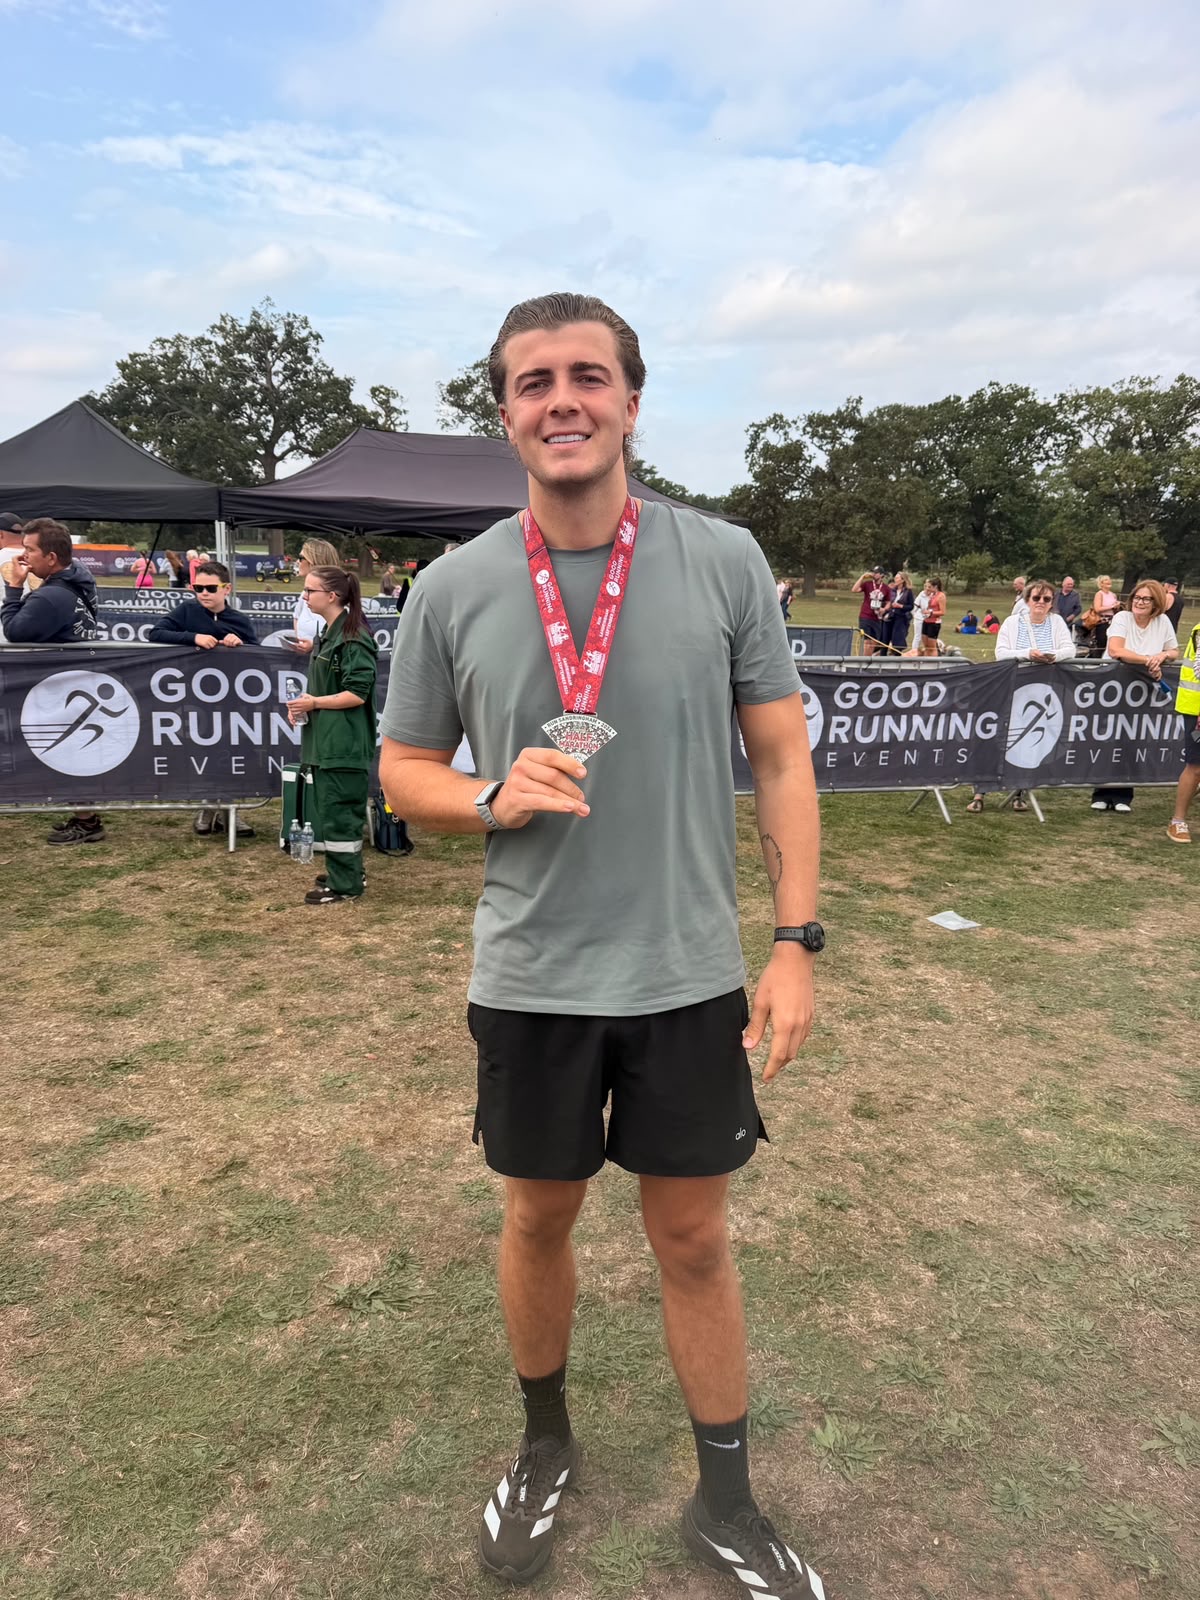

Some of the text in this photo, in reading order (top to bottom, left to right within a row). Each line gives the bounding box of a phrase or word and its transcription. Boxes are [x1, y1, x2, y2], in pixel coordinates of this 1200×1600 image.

[609, 560, 617, 580] GOOD
[614, 554, 624, 583] RUNNING
[542, 584, 554, 613] RUNNING
[547, 582, 556, 600] GOOD
[150, 667, 308, 704] GOOD
[834, 681, 947, 709] GOOD
[1074, 680, 1172, 708] GOOD
[573, 692, 583, 713] GOOD
[152, 711, 302, 746] RUNN
[565, 731, 593, 741] HALF
[828, 711, 998, 744] RUNNING
[1068, 713, 1185, 742] RUNNIN
[560, 741, 599, 751] MARATHON
[826, 748, 968, 767] EVENTS
[154, 756, 285, 775] EVEN
[735, 1127, 747, 1141] alo
